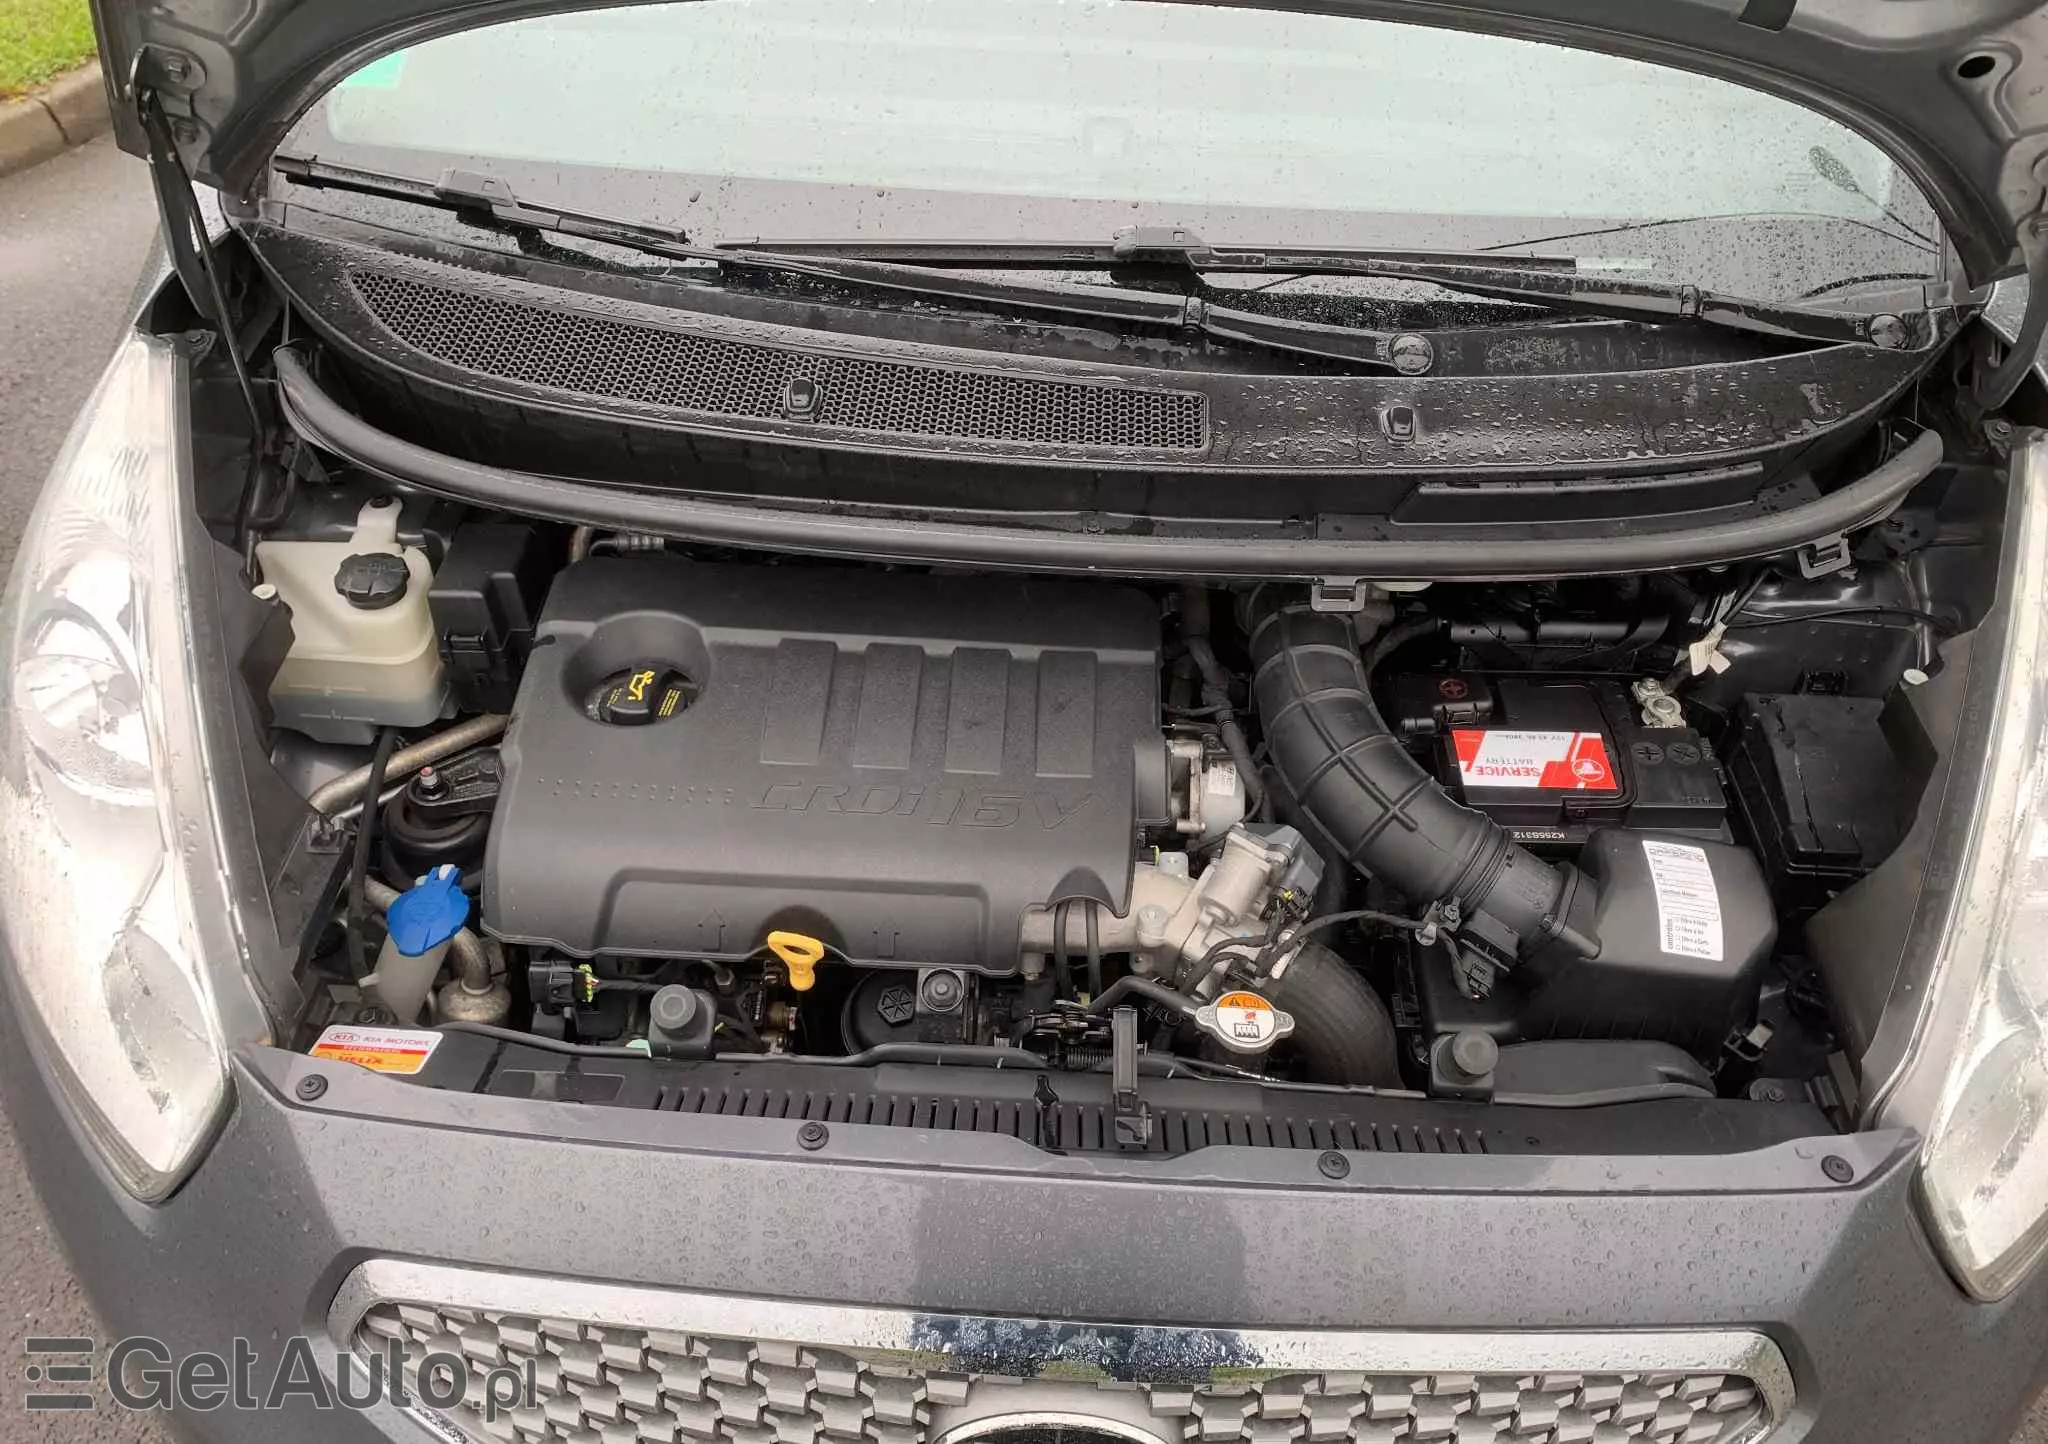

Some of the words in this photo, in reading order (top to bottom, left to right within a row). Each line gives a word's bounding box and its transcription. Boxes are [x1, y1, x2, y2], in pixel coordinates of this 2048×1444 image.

[1485, 757, 1534, 766] BATTERY
[1474, 766, 1541, 778] SERVICE
[382, 1037, 433, 1046] MOTORS
